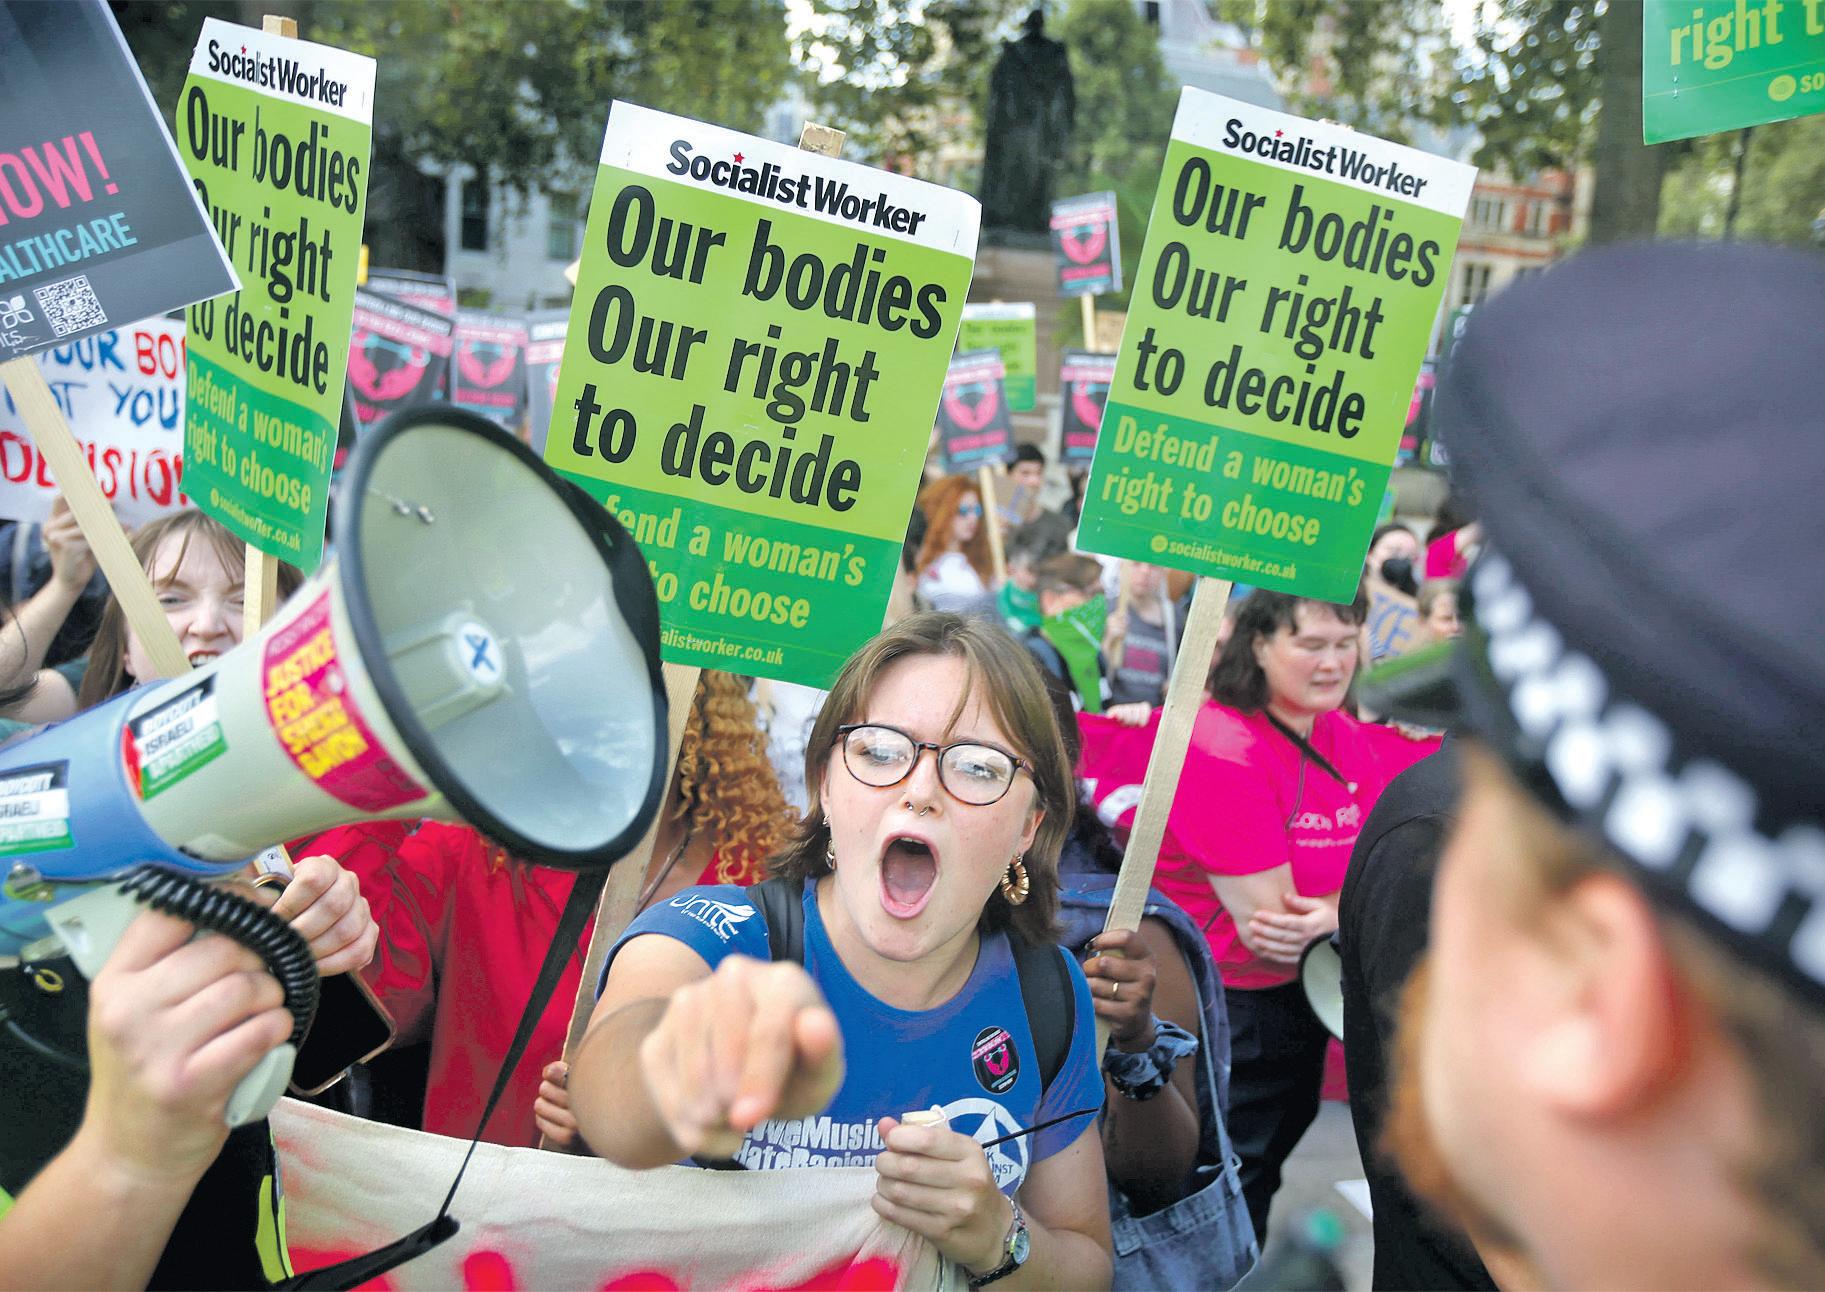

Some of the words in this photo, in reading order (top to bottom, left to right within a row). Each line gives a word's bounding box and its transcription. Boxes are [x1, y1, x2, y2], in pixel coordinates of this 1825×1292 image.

[1671, 0, 1783, 70] right
[0, 131, 119, 225] OW!
[187, 86, 245, 172] Our
[252, 105, 360, 215] bodies
[248, 206, 332, 303] right
[606, 185, 726, 284] Our
[742, 218, 947, 340] bodies
[1172, 156, 1266, 240] Our
[1279, 184, 1440, 288] bodies
[225, 290, 328, 395] decide
[1152, 241, 1247, 323] Our
[1260, 274, 1384, 361] right
[134, 331, 187, 380] BO
[588, 284, 708, 381] Our
[723, 324, 880, 424] right
[1133, 327, 1185, 396] to
[1204, 344, 1365, 439] decide
[187, 414, 217, 465] right
[222, 435, 236, 477] to
[241, 450, 311, 513] choose
[188, 360, 237, 424] Defend
[238, 402, 248, 432] a
[254, 410, 328, 474] woman's
[572, 383, 637, 464] to
[660, 403, 862, 512] decide
[1113, 415, 1218, 473] Defend
[1223, 449, 1243, 479] a
[1252, 457, 1365, 506] woman's
[688, 524, 711, 557] a
[724, 531, 866, 587] woman's
[1102, 467, 1173, 515] right
[1181, 480, 1212, 521] to
[1222, 494, 1320, 546] choose
[689, 573, 810, 629] choose
[1168, 541, 1297, 580] socialistworker.co.uk
